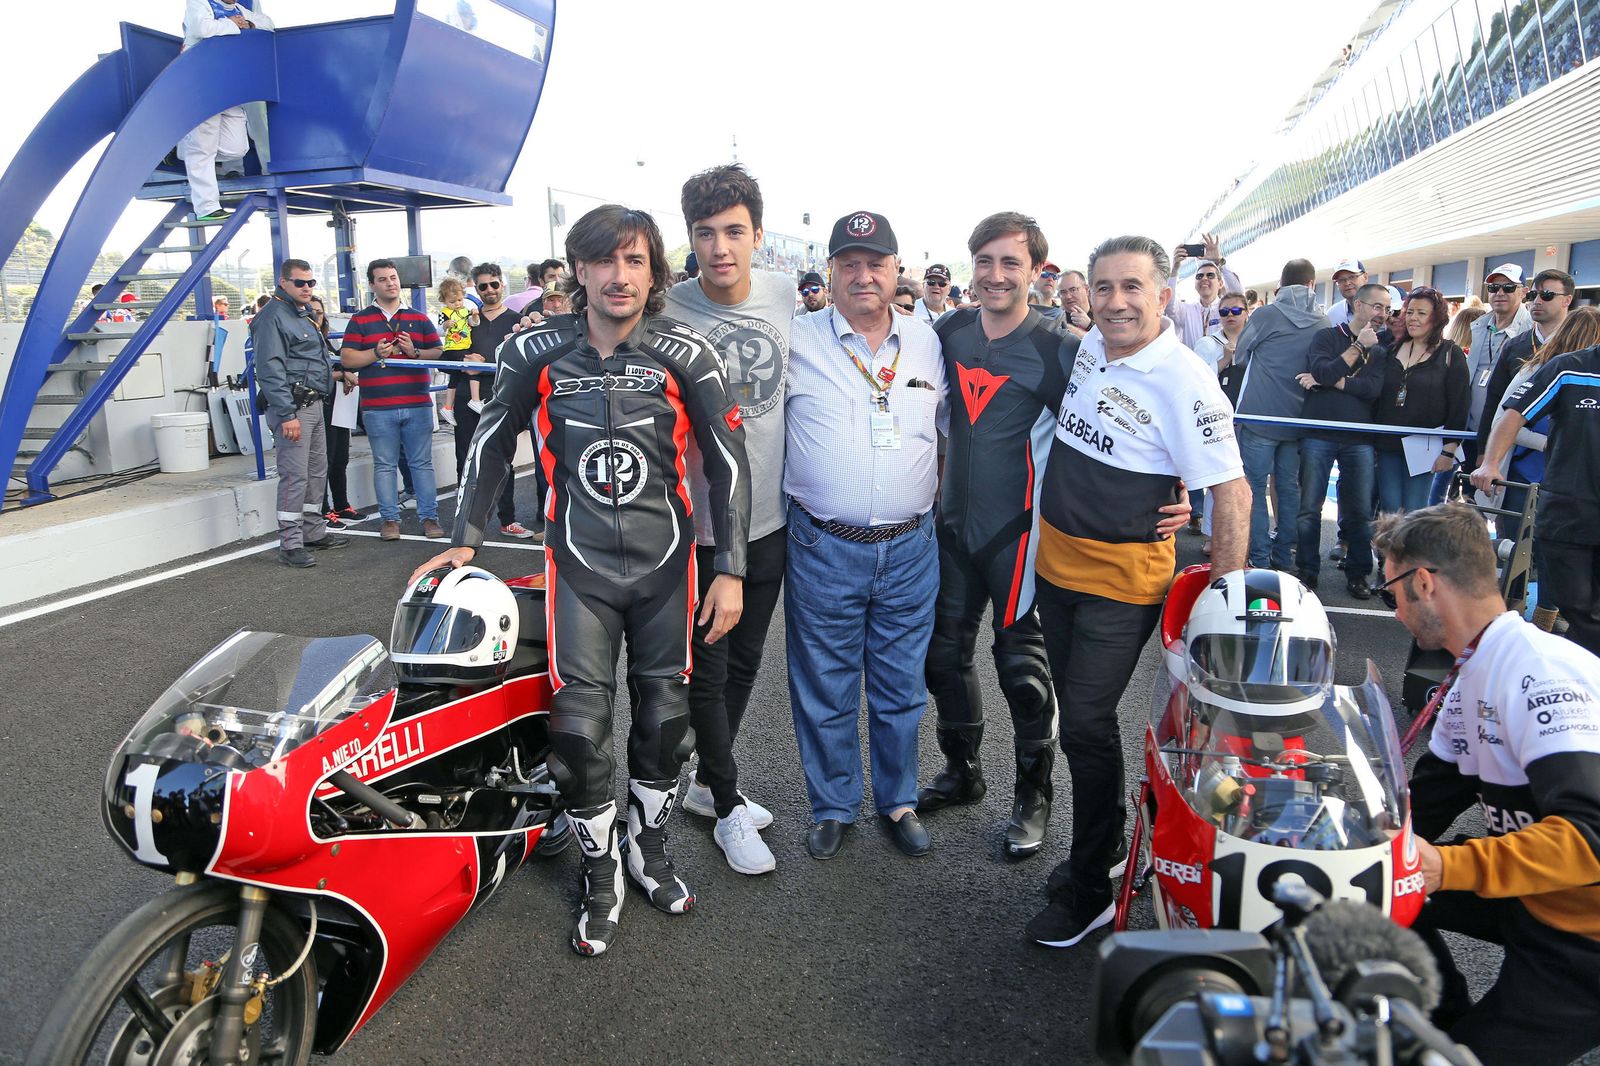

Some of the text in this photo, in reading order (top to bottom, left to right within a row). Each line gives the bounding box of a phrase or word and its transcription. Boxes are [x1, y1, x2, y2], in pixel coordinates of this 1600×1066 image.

[852, 217, 870, 230] 12
[718, 336, 775, 385] 12
[652, 372, 664, 381] YOU
[553, 376, 659, 396] SPIDI
[1114, 417, 1137, 435] DUCATI
[1196, 411, 1231, 427] ARIZON
[584, 442, 602, 458] ALWAYS
[592, 452, 633, 483] 12
[417, 585, 435, 593] agv
[494, 651, 507, 660] agv
[1527, 690, 1594, 711] ARIZONA
[317, 721, 425, 791] ARELLI
[125, 763, 170, 865] 1
